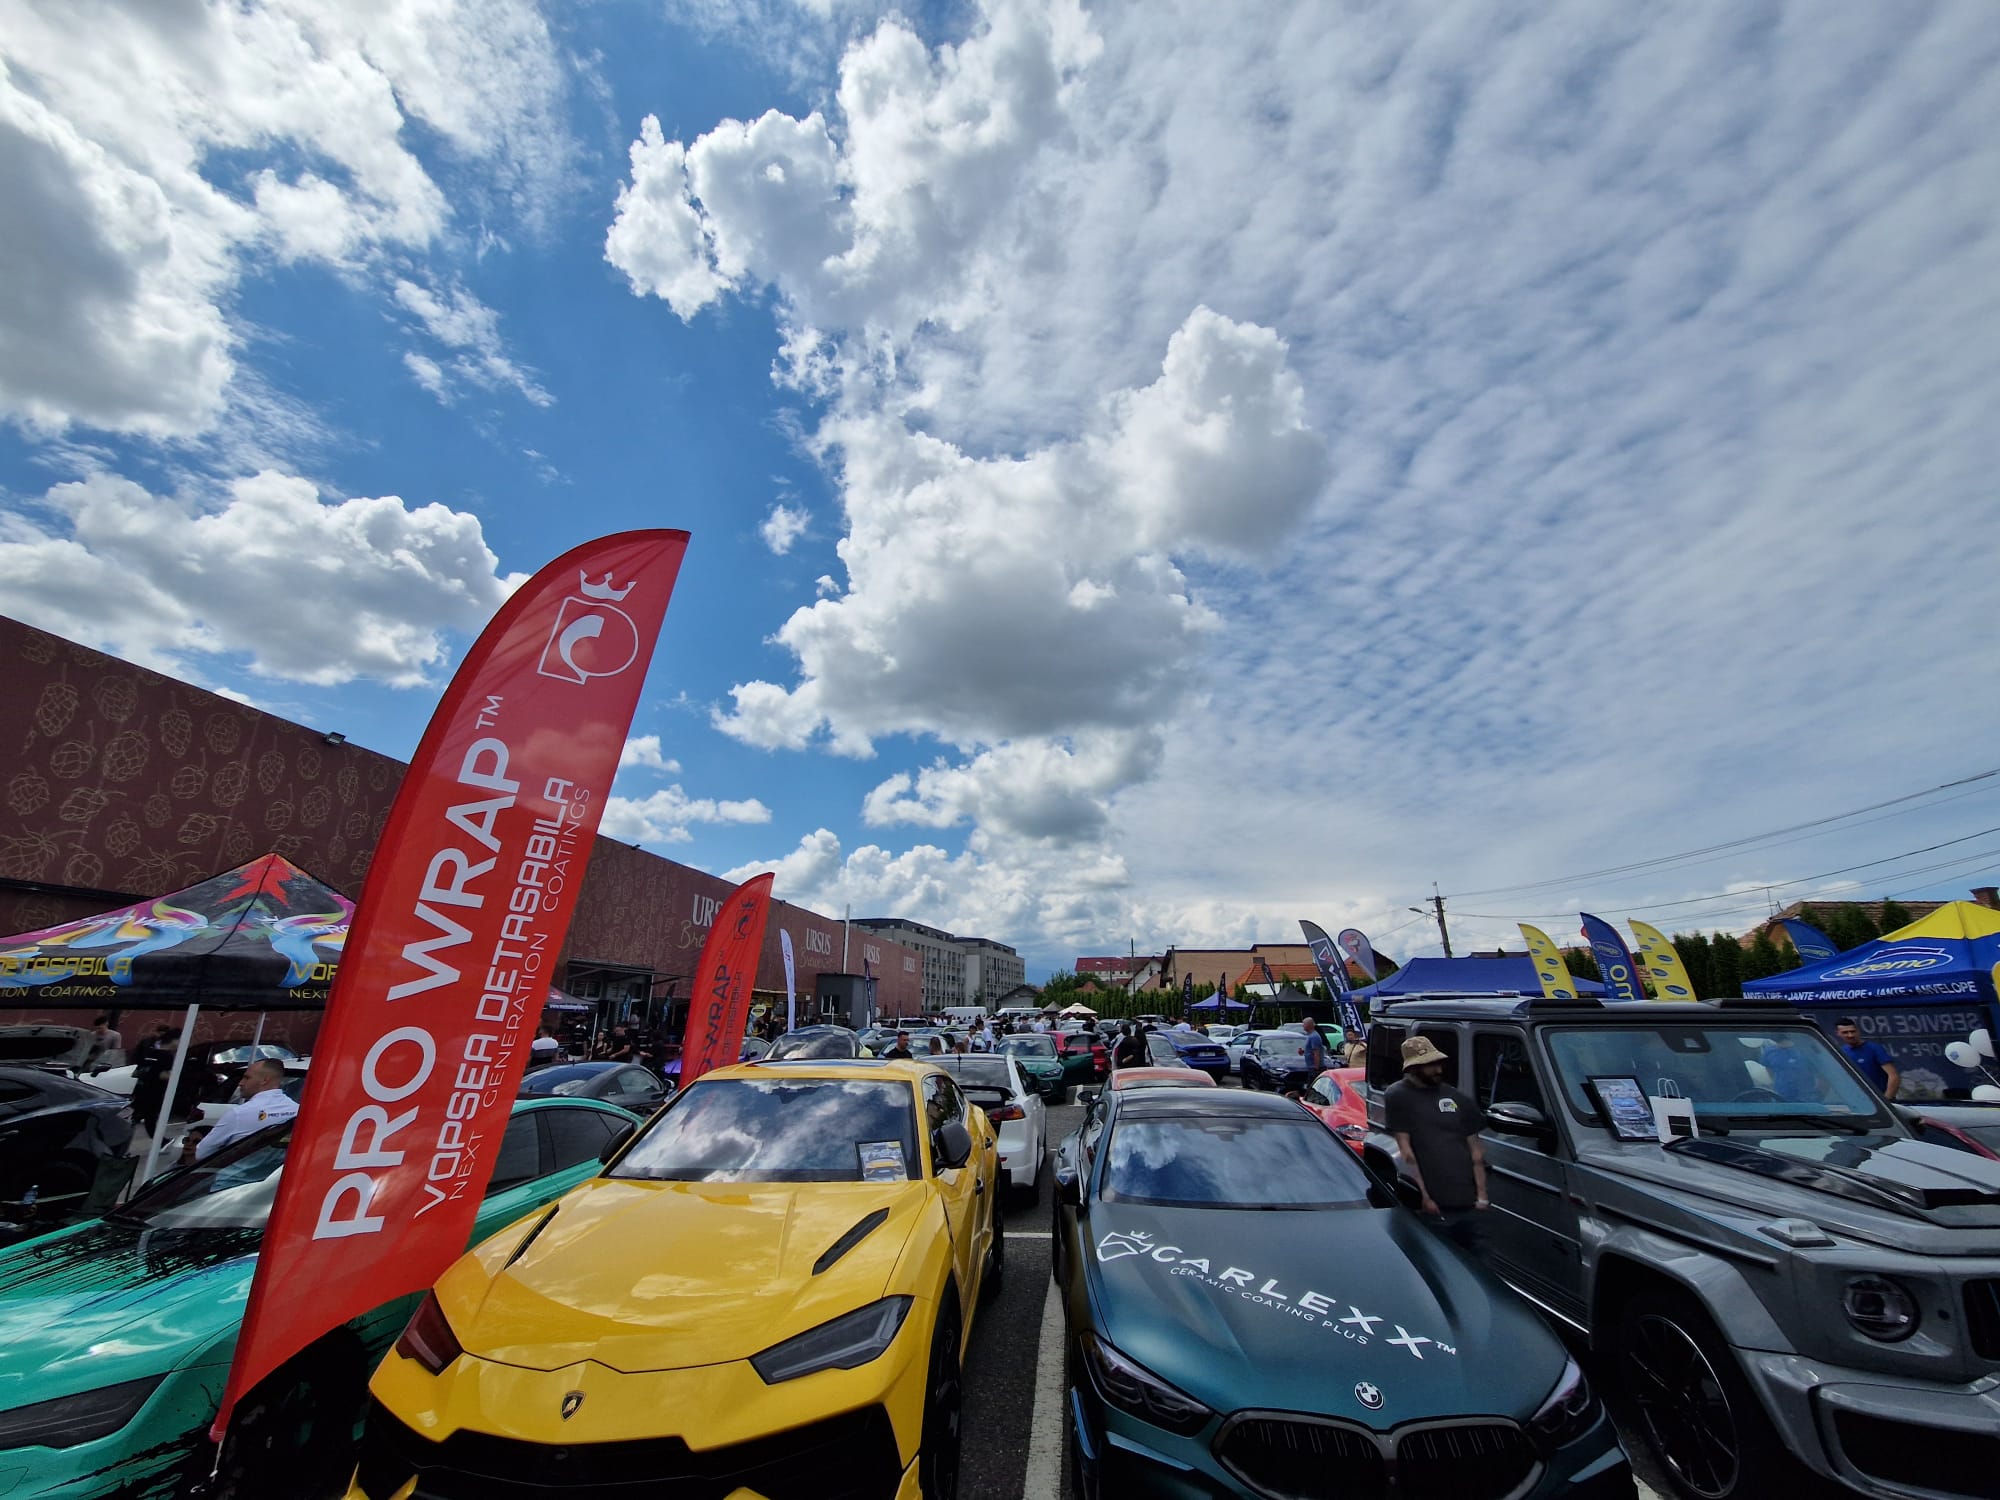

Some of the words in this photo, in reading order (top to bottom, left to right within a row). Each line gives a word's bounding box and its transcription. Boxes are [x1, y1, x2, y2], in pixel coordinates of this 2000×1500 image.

[806, 927, 832, 955] URSUS
[39, 985, 118, 998] COATINGS
[312, 1026, 437, 1241] PRO
[386, 737, 520, 1002] WRAP
[413, 1033, 499, 1220] VOPSEA
[475, 777, 574, 1022] DETASABILA
[448, 1133, 483, 1201] NEXT
[482, 933, 548, 1108] GENERATION
[543, 788, 590, 912] COATINGS
[703, 964, 731, 1051] WRAP
[1788, 991, 1815, 1000] JANTE
[1819, 989, 1868, 999] ANVELOPE
[1150, 1245, 1432, 1360] CARLEXX
[1169, 1266, 1234, 1295] CERAMIC
[1240, 1291, 1315, 1322] COATING
[1321, 1319, 1370, 1346] PLUS
